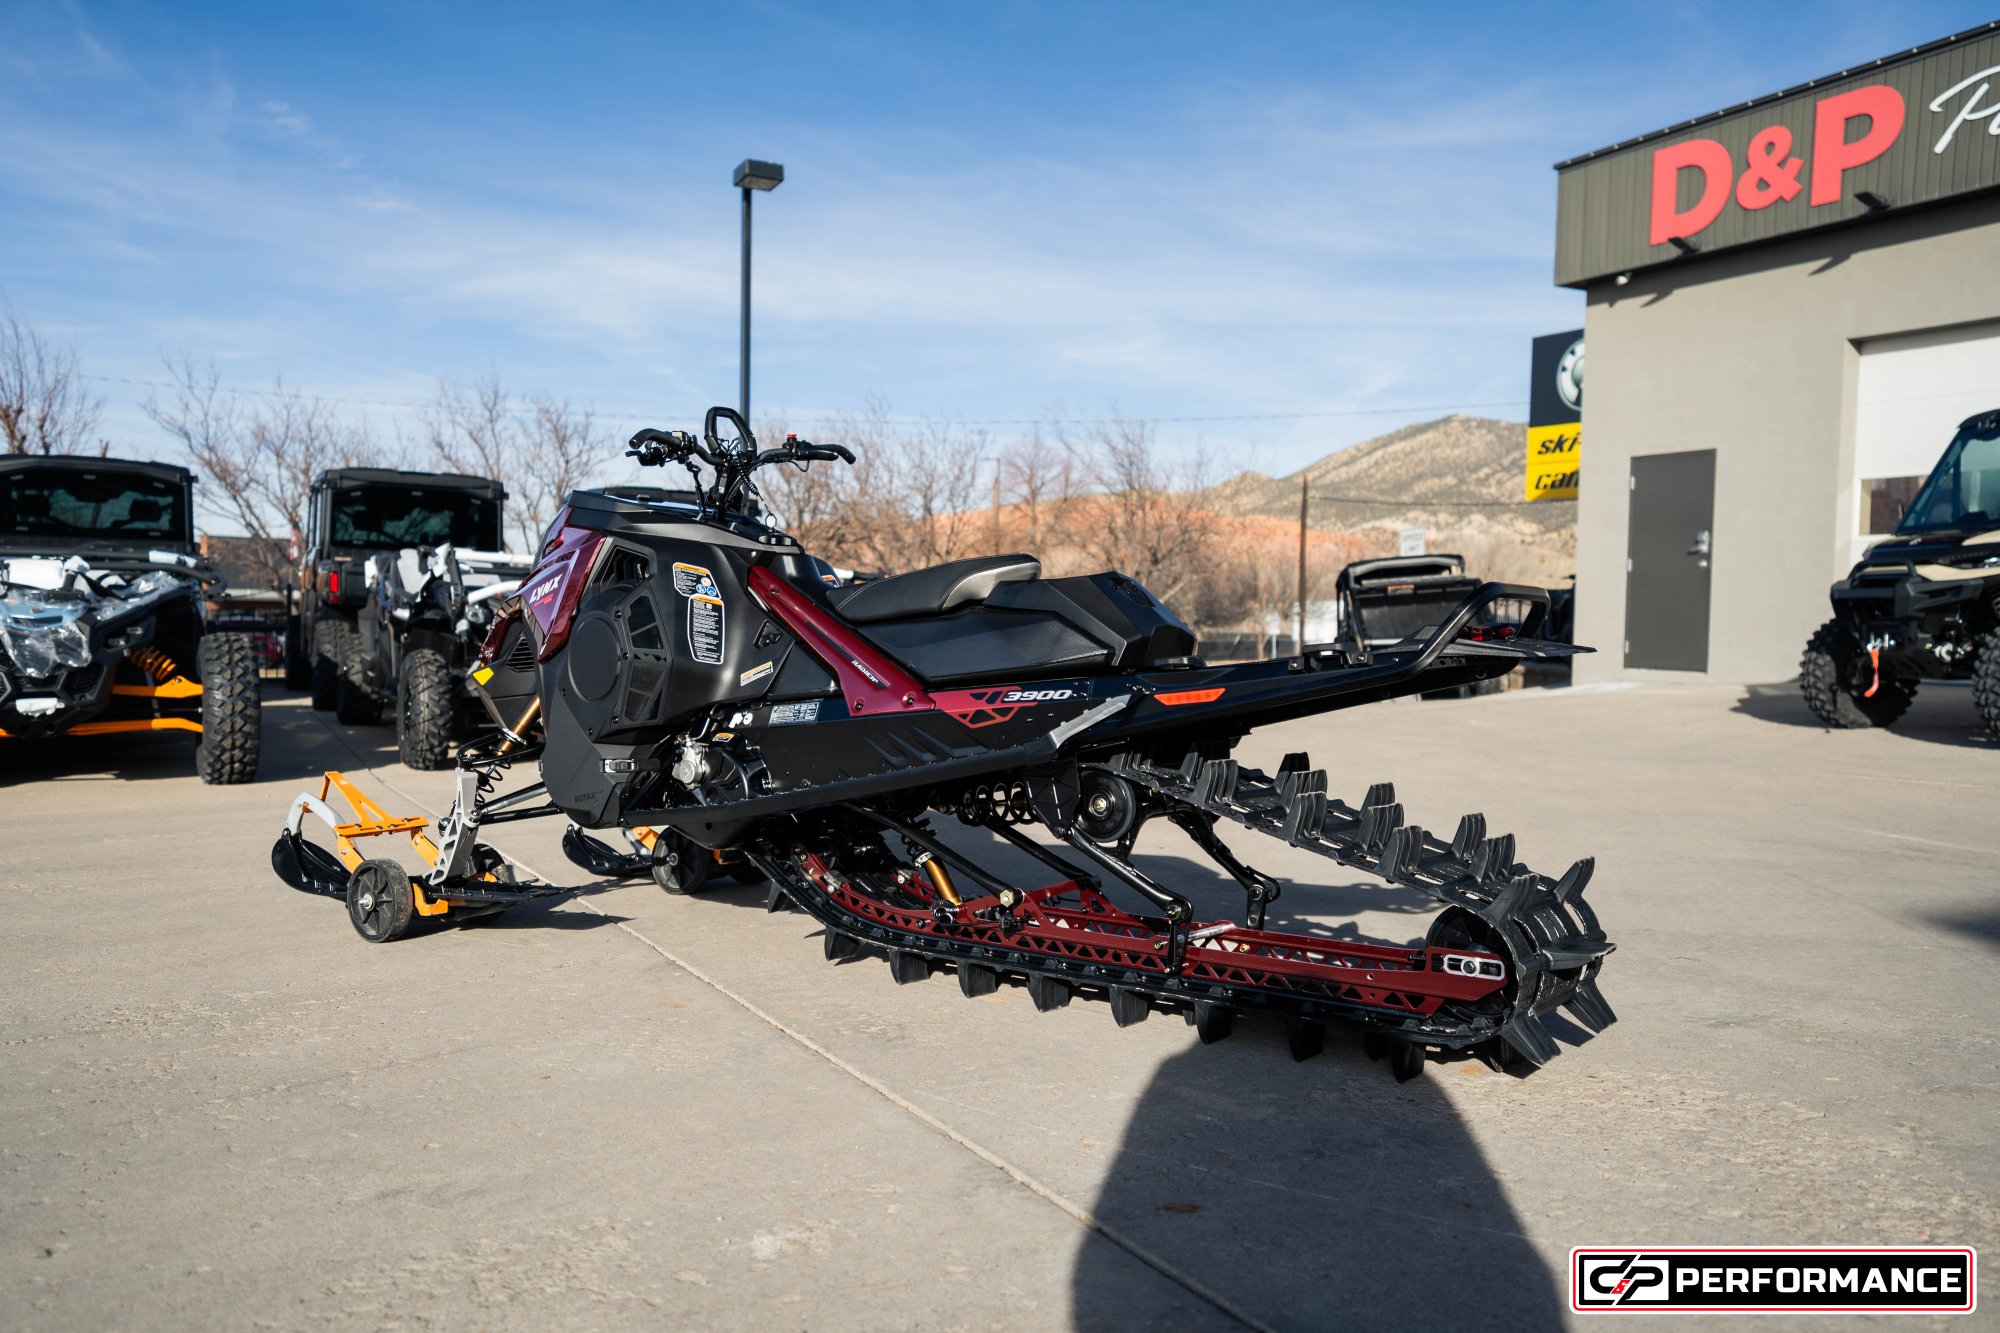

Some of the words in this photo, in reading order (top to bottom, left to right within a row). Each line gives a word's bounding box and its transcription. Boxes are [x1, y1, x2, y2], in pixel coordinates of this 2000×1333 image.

[1650, 84, 1905, 246] D&P
[529, 573, 562, 604] LYNX
[1003, 689, 1072, 701] 3900
